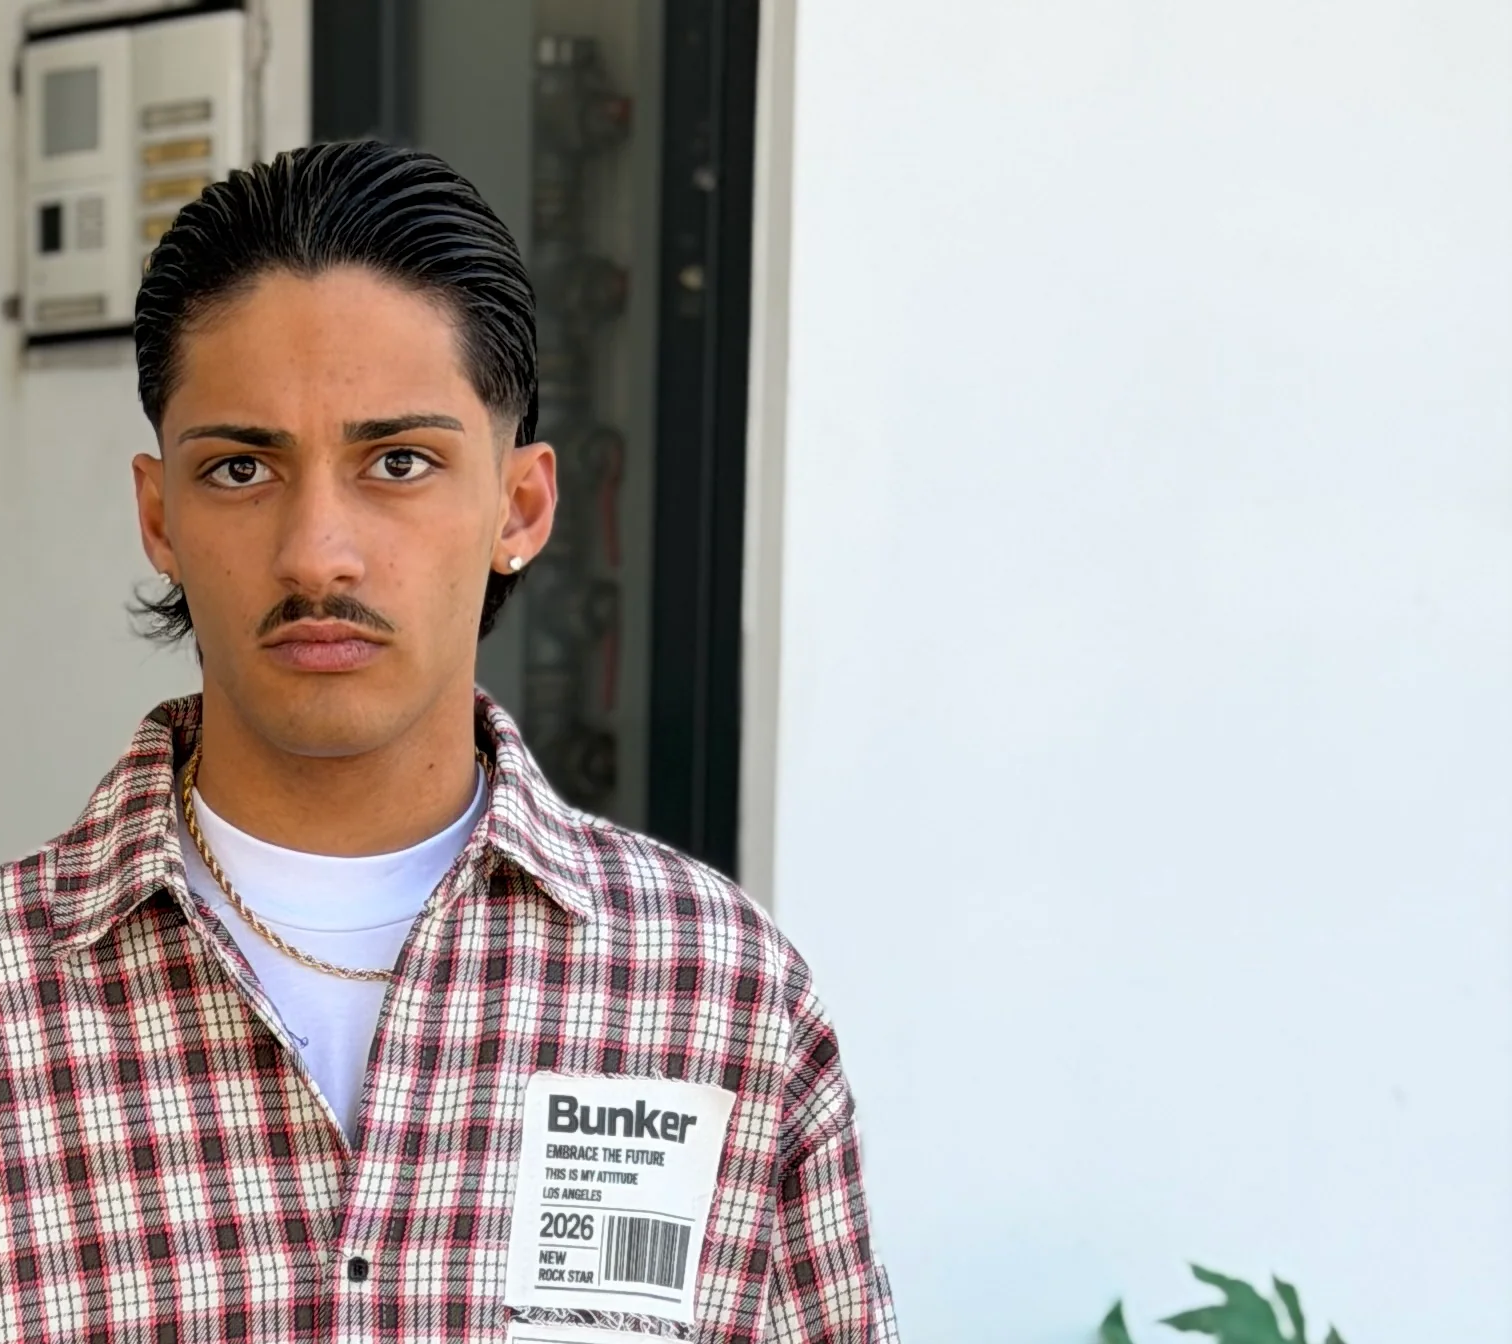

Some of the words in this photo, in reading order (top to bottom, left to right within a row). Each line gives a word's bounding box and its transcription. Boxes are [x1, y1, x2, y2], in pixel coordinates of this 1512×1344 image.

[548, 1094, 697, 1144] Bunker
[546, 1144, 599, 1162] EMBRACE
[602, 1147, 622, 1163] THE
[625, 1149, 666, 1166] FUTURE
[545, 1167, 566, 1180] THIS
[568, 1168, 578, 1181] IS
[580, 1169, 595, 1182] MY
[596, 1170, 638, 1185] ATTITUDE
[543, 1187, 560, 1200] LOS
[561, 1188, 602, 1202] ANGELES
[539, 1212, 594, 1240] 2026
[539, 1250, 566, 1265] NEW
[538, 1268, 565, 1282] ROCK
[567, 1270, 594, 1284] STAR
